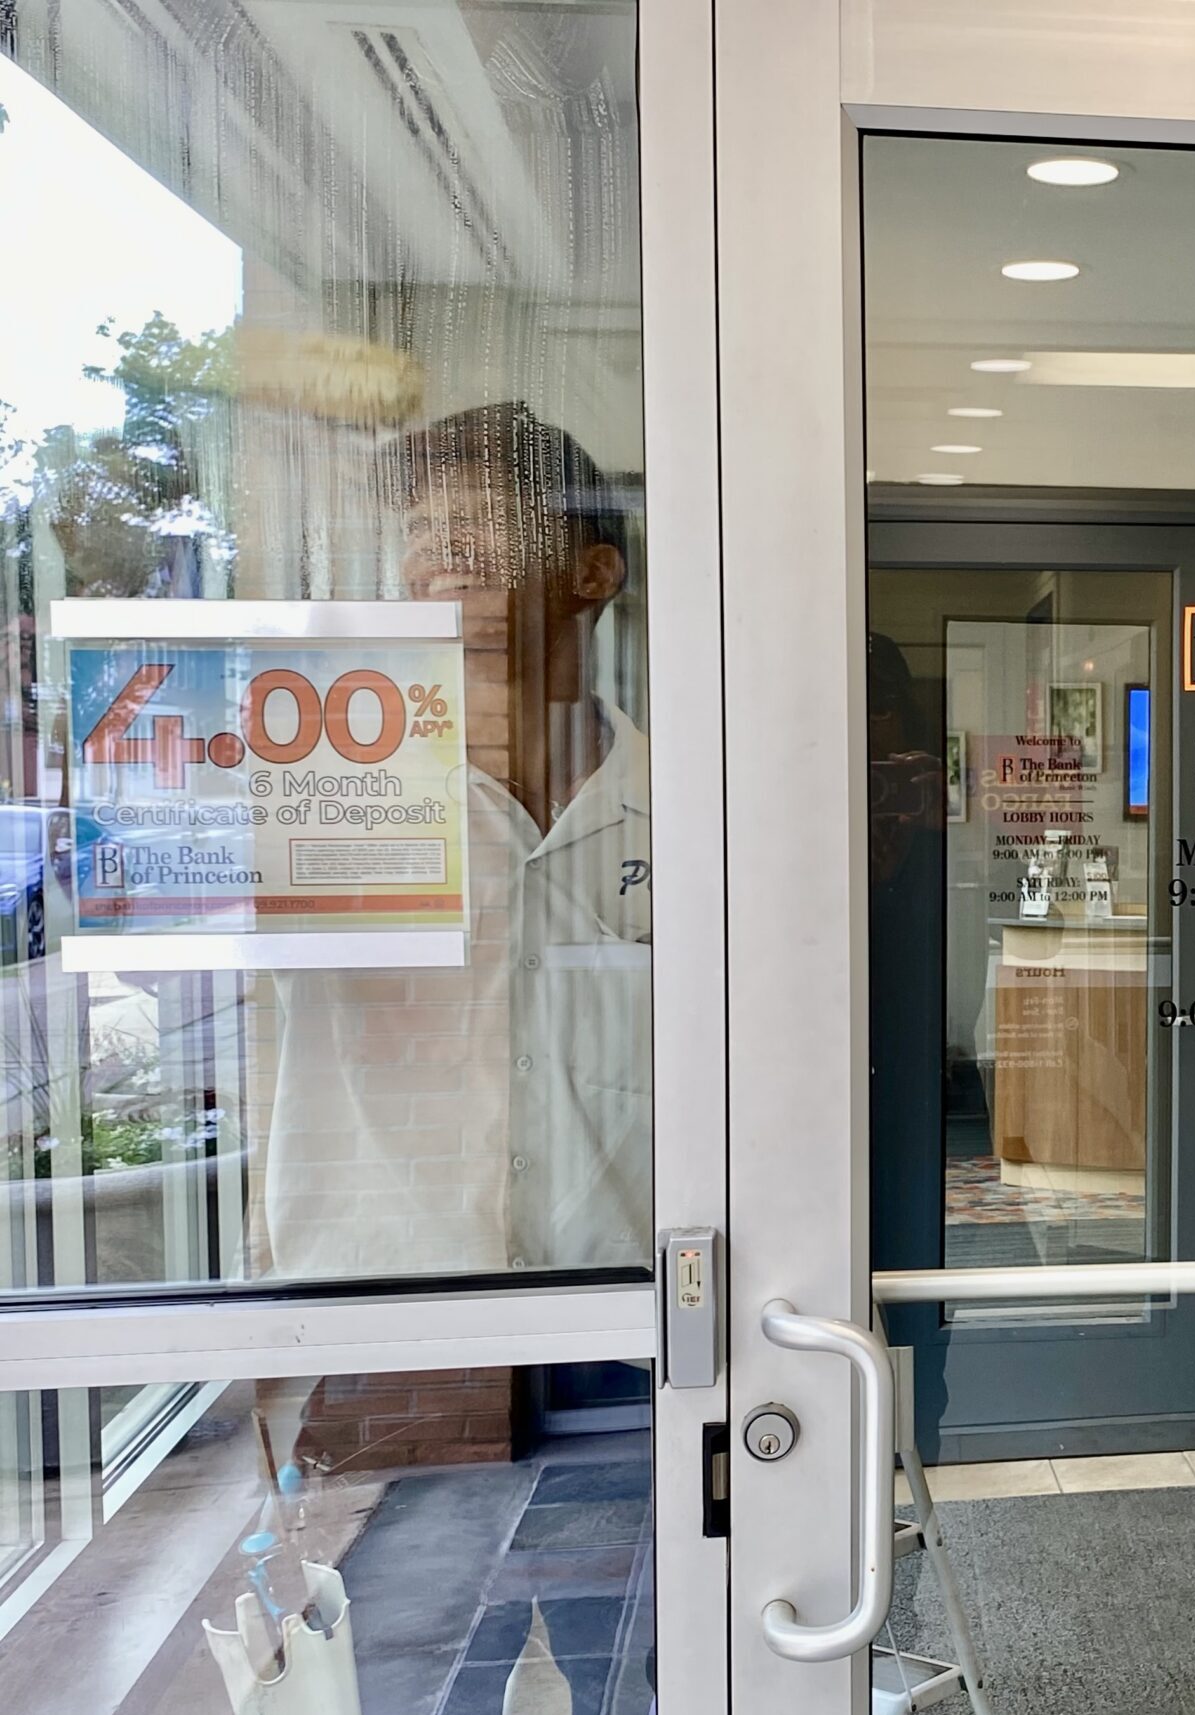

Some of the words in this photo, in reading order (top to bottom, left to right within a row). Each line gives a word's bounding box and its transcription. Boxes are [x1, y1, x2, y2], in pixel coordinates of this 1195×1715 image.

[83, 664, 407, 789] 4.00
[1016, 735, 1066, 746] Welcome
[1020, 758, 1045, 770] The
[1048, 758, 1082, 770] Bank
[249, 770, 273, 797] 6
[283, 769, 403, 797] Month
[1020, 770, 1033, 782] of
[1036, 771, 1097, 783] Princeton
[92, 799, 267, 827] Certificate
[277, 798, 314, 826] of
[319, 797, 446, 831] Deposit
[1003, 812, 1045, 822] LOBBY
[1050, 812, 1094, 822] HOURS
[996, 835, 1047, 846] MONDAY
[1058, 835, 1101, 846] FRIDAY
[131, 846, 172, 865] The
[178, 845, 235, 865] Bank
[993, 849, 1018, 860] 9:00
[131, 866, 154, 884] of
[158, 866, 264, 884] Princeton
[619, 859, 651, 895] P
[989, 892, 1015, 902] 9:00
[1055, 891, 1086, 901] 12:00
[1090, 891, 1108, 901] PM
